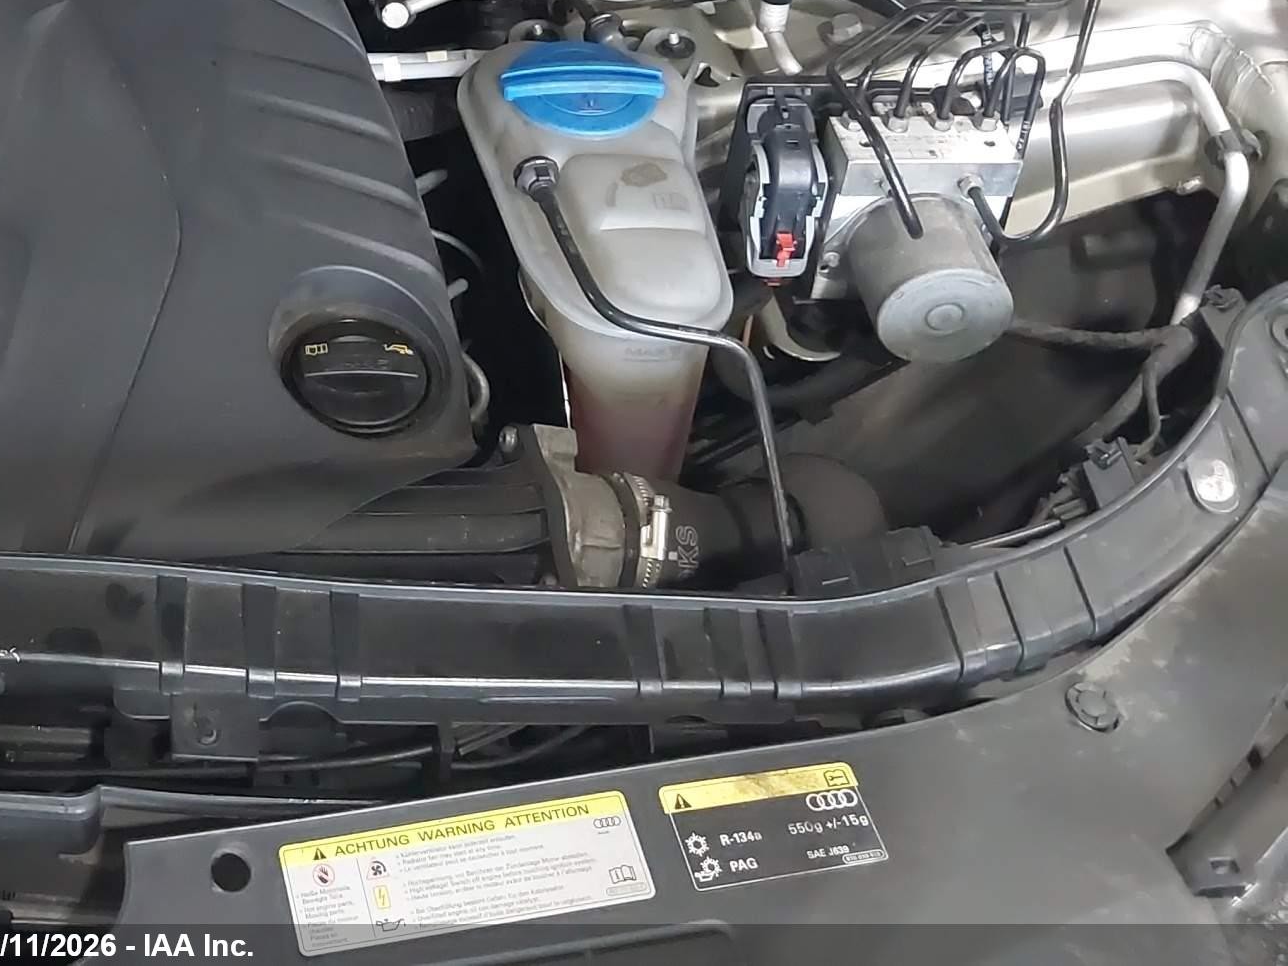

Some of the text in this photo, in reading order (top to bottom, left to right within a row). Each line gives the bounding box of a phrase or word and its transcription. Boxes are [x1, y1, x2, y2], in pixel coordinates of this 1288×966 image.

[334, 835, 410, 857] ACHTUNG
[417, 821, 495, 842] WARNING
[504, 804, 590, 828] ATTENTION
[788, 813, 869, 836] 550g +/-15g
[720, 831, 762, 847] R-134a
[806, 848, 826, 859] SAE
[729, 858, 759, 873] PAG
